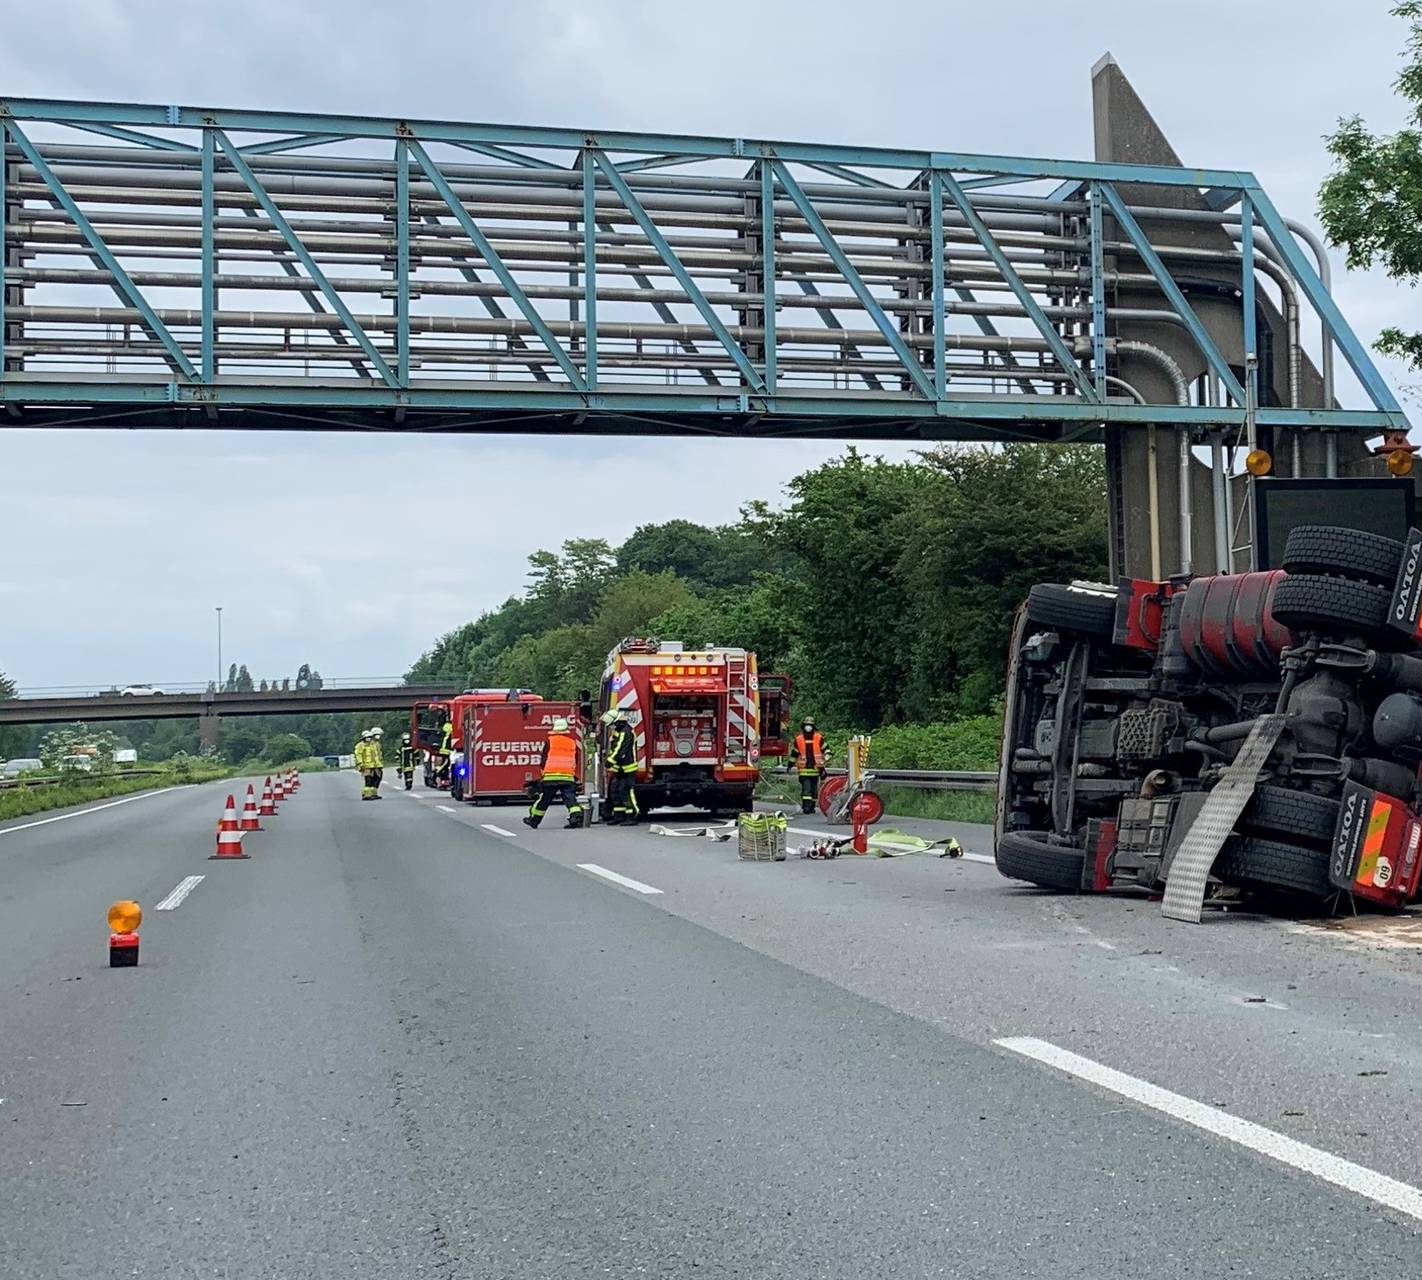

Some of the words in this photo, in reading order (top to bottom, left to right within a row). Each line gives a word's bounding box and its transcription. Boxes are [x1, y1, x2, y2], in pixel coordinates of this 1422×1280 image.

[1396, 541, 1422, 620] VOLVO
[481, 741, 545, 753] FEUERW
[481, 755, 542, 766] GLADB
[1334, 792, 1358, 877] VOLVO
[1379, 865, 1391, 880] 60
